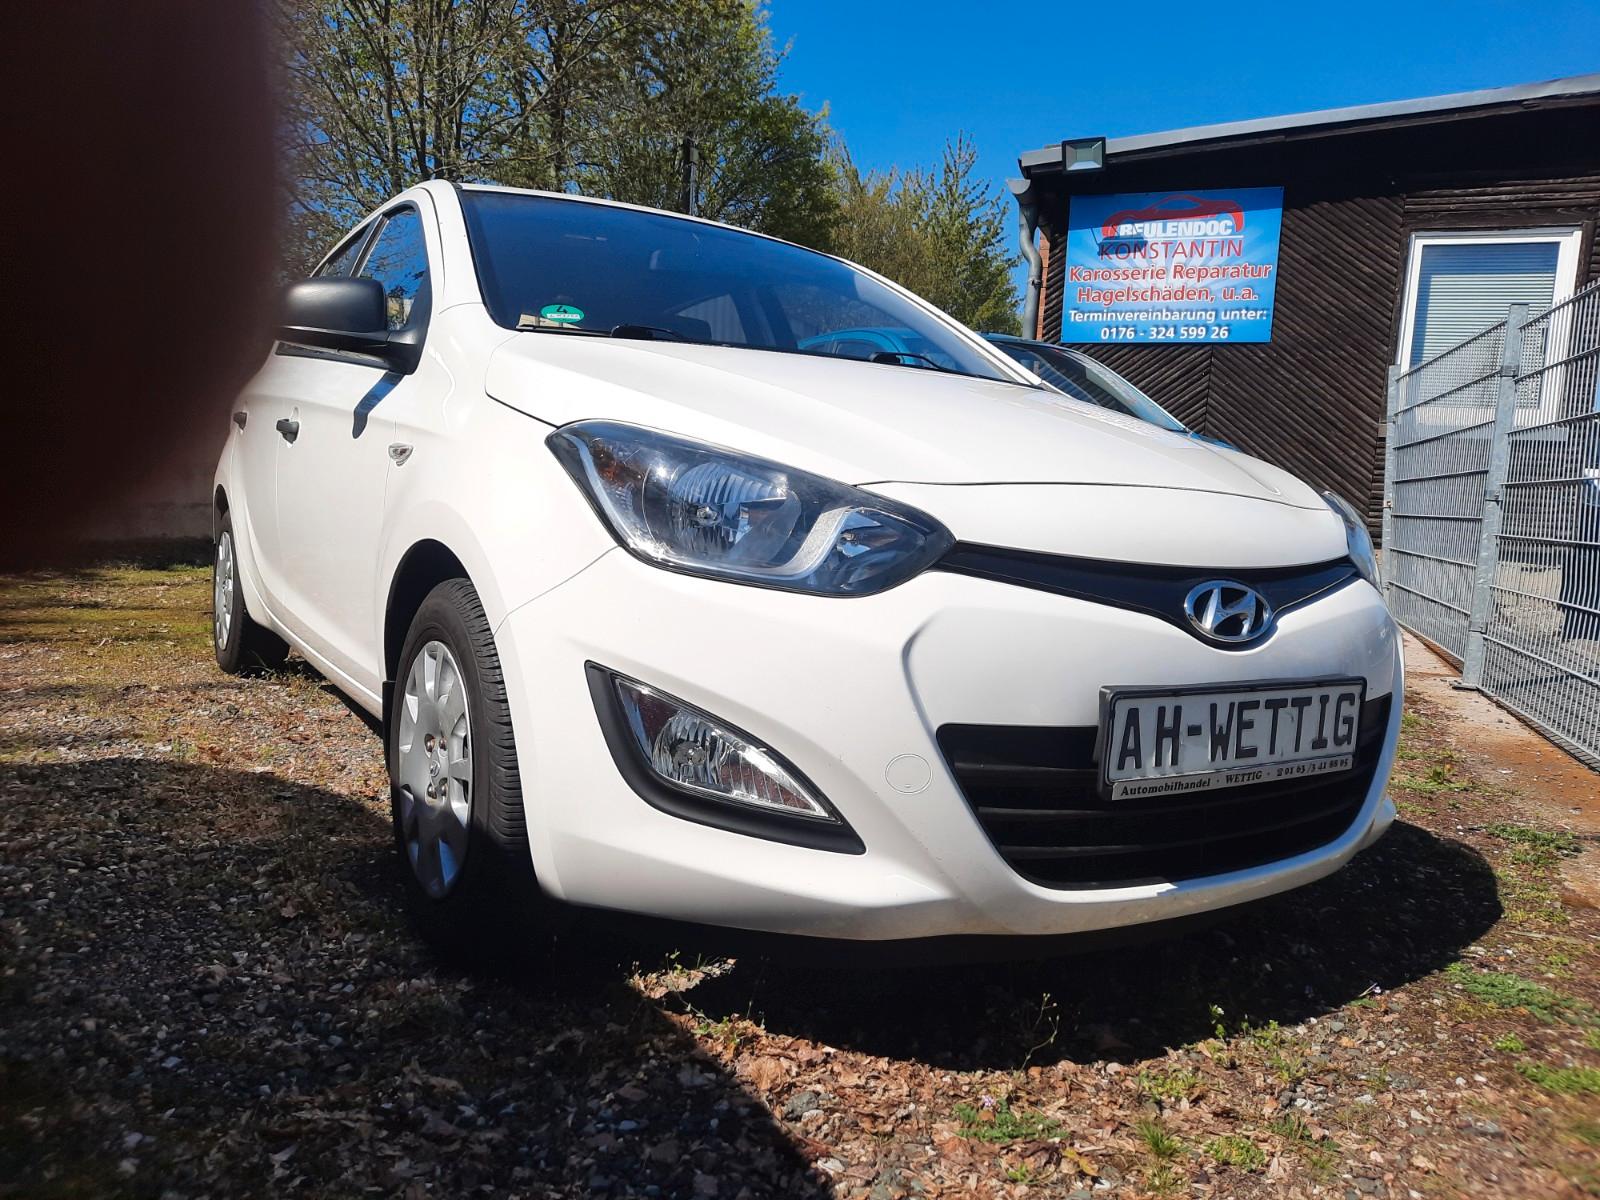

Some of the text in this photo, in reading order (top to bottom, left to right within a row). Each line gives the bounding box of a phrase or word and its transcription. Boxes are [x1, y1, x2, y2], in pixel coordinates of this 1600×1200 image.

[1100, 239, 1243, 260] KONSTANTIN
[1070, 263, 1272, 282] Karosserie Reparatur
[1078, 285, 1258, 305] Hagelschäden, u.a.
[1069, 307, 1267, 322] Terminvereinbarung unter:
[1101, 327, 1135, 339] 0176
[1150, 327, 1175, 339] 324
[1180, 327, 1206, 339] 599
[1211, 326, 1229, 339] 26
[1120, 778, 1211, 796] Automobilhandel
[1225, 770, 1263, 784] WETTIG
